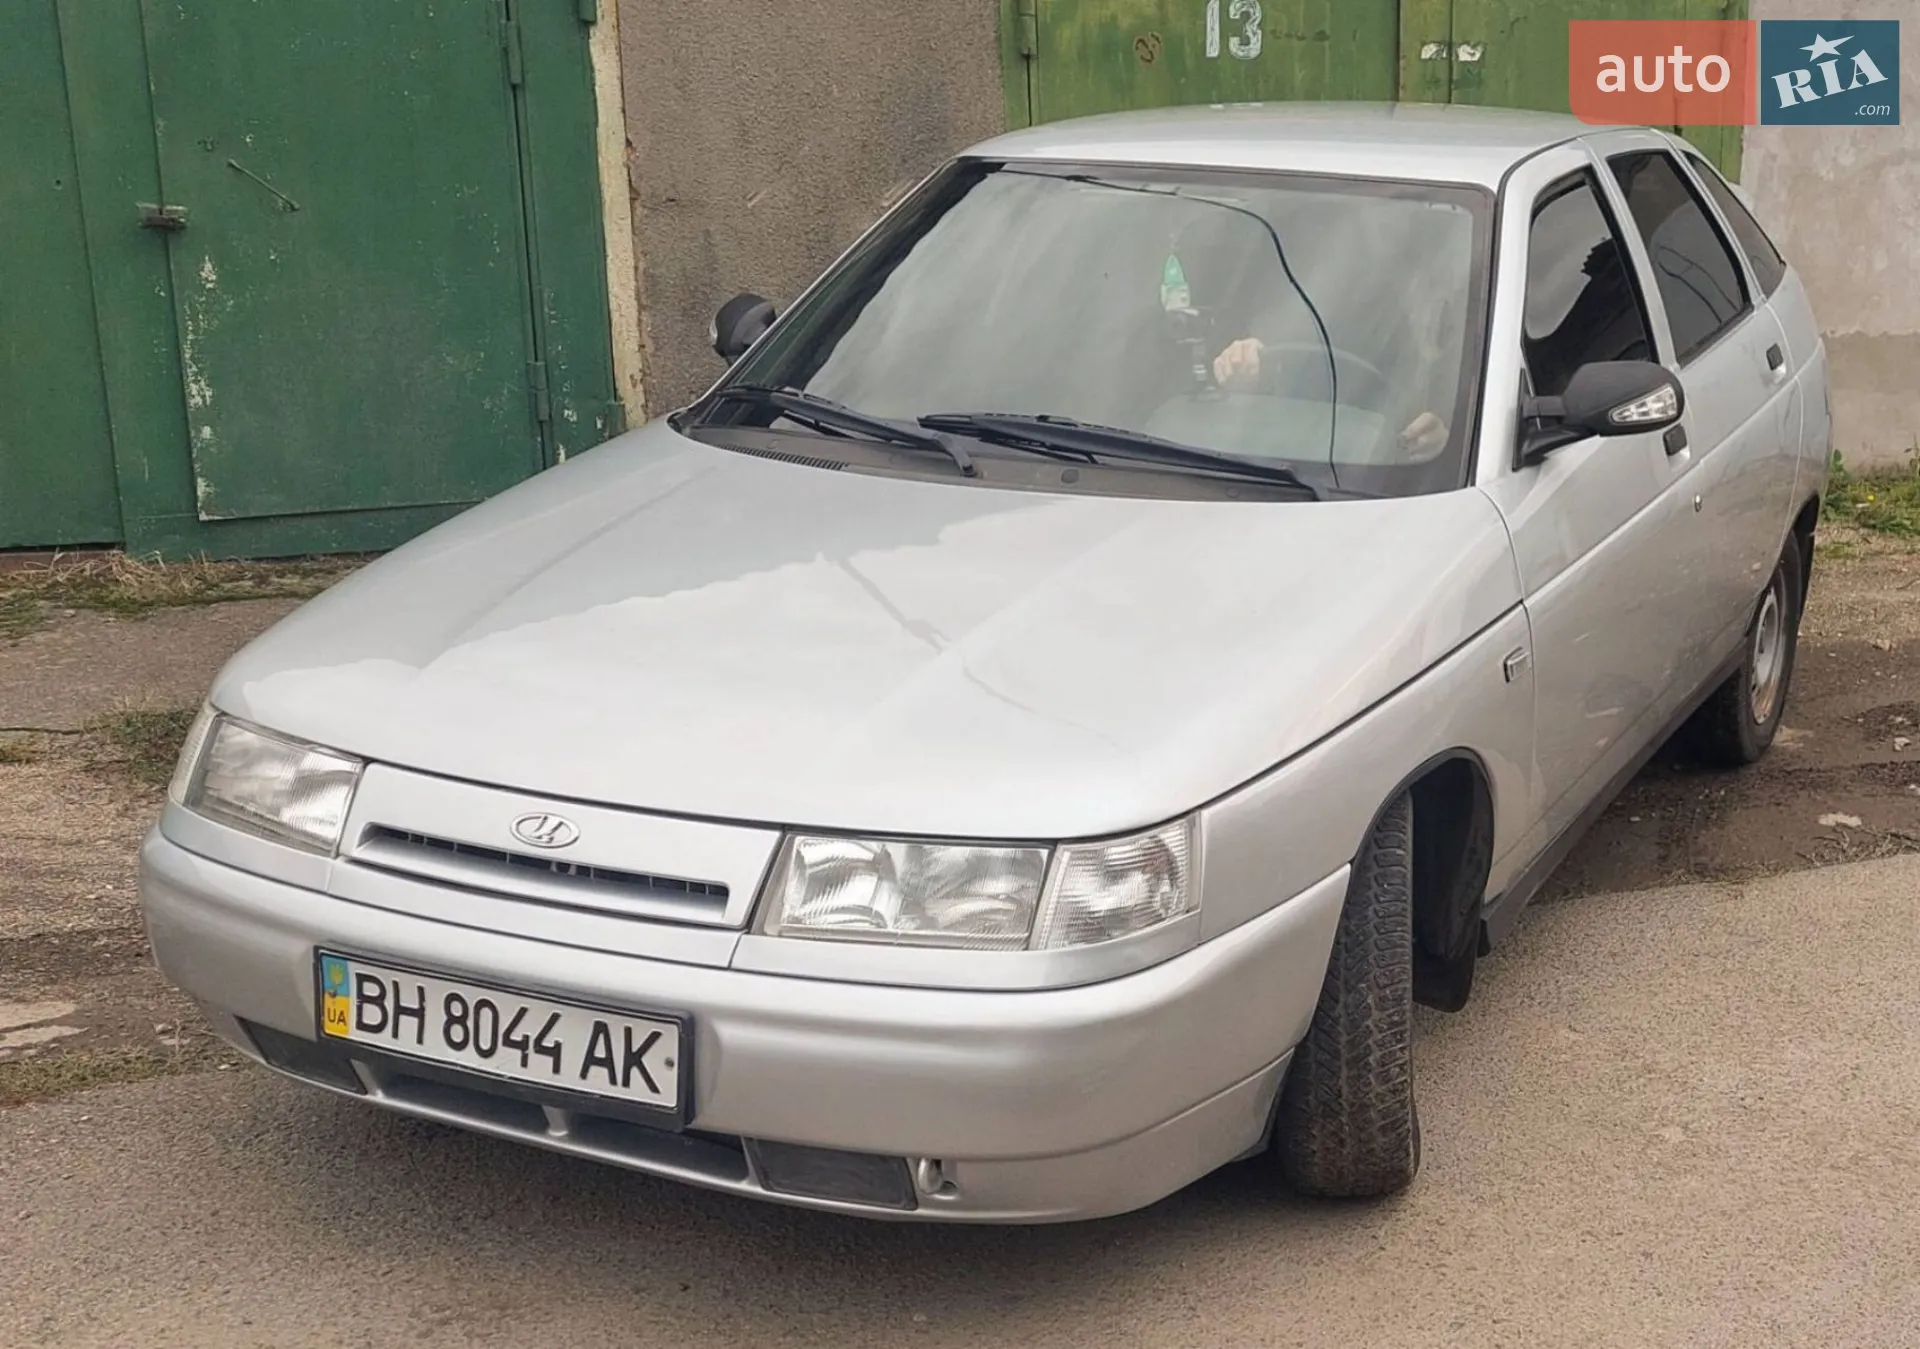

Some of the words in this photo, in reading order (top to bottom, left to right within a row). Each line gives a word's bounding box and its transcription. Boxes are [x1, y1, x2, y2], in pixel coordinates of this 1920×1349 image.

[1206, 0, 1262, 59] 13
[326, 1008, 347, 1027] UA
[354, 972, 426, 1046] BH
[442, 992, 563, 1075] 8044
[579, 1019, 663, 1094] AK
